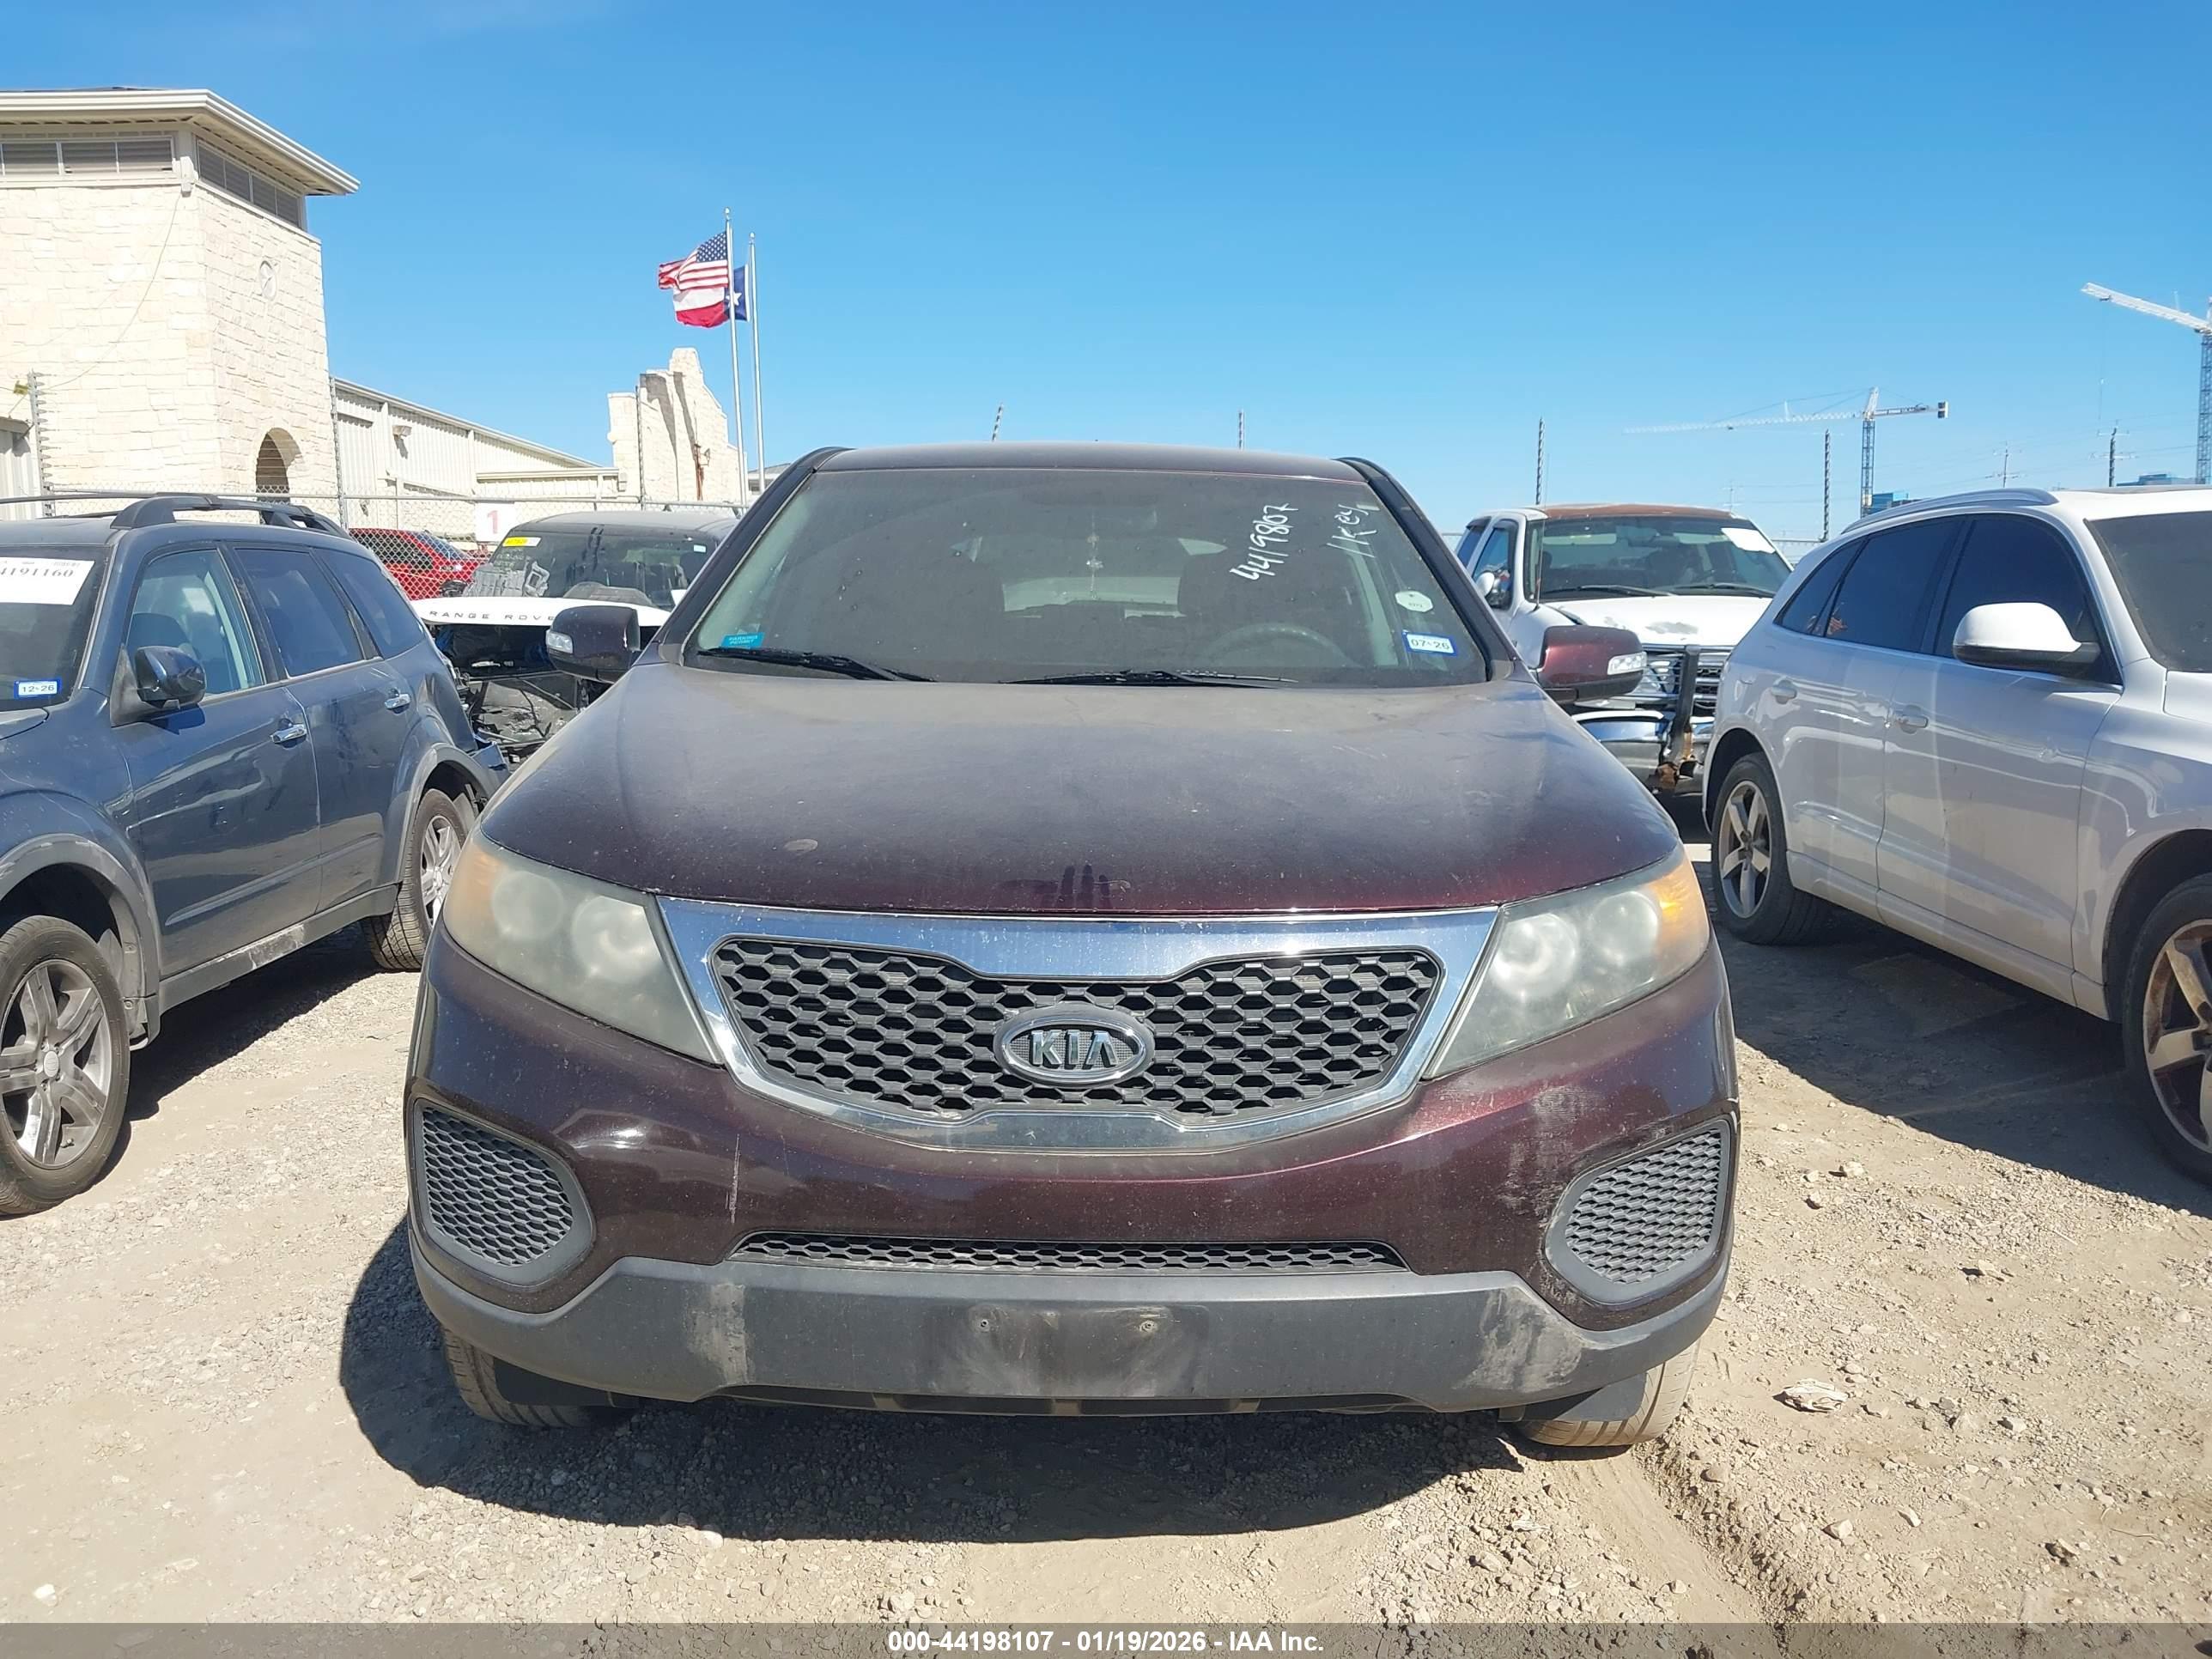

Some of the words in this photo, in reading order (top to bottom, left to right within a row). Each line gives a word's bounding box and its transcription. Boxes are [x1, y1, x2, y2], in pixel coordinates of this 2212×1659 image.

[487, 509, 499, 534] 1
[1230, 503, 1298, 580] 44198107
[429, 611, 490, 619] RANGE
[1030, 1030, 1118, 1067] KIA
